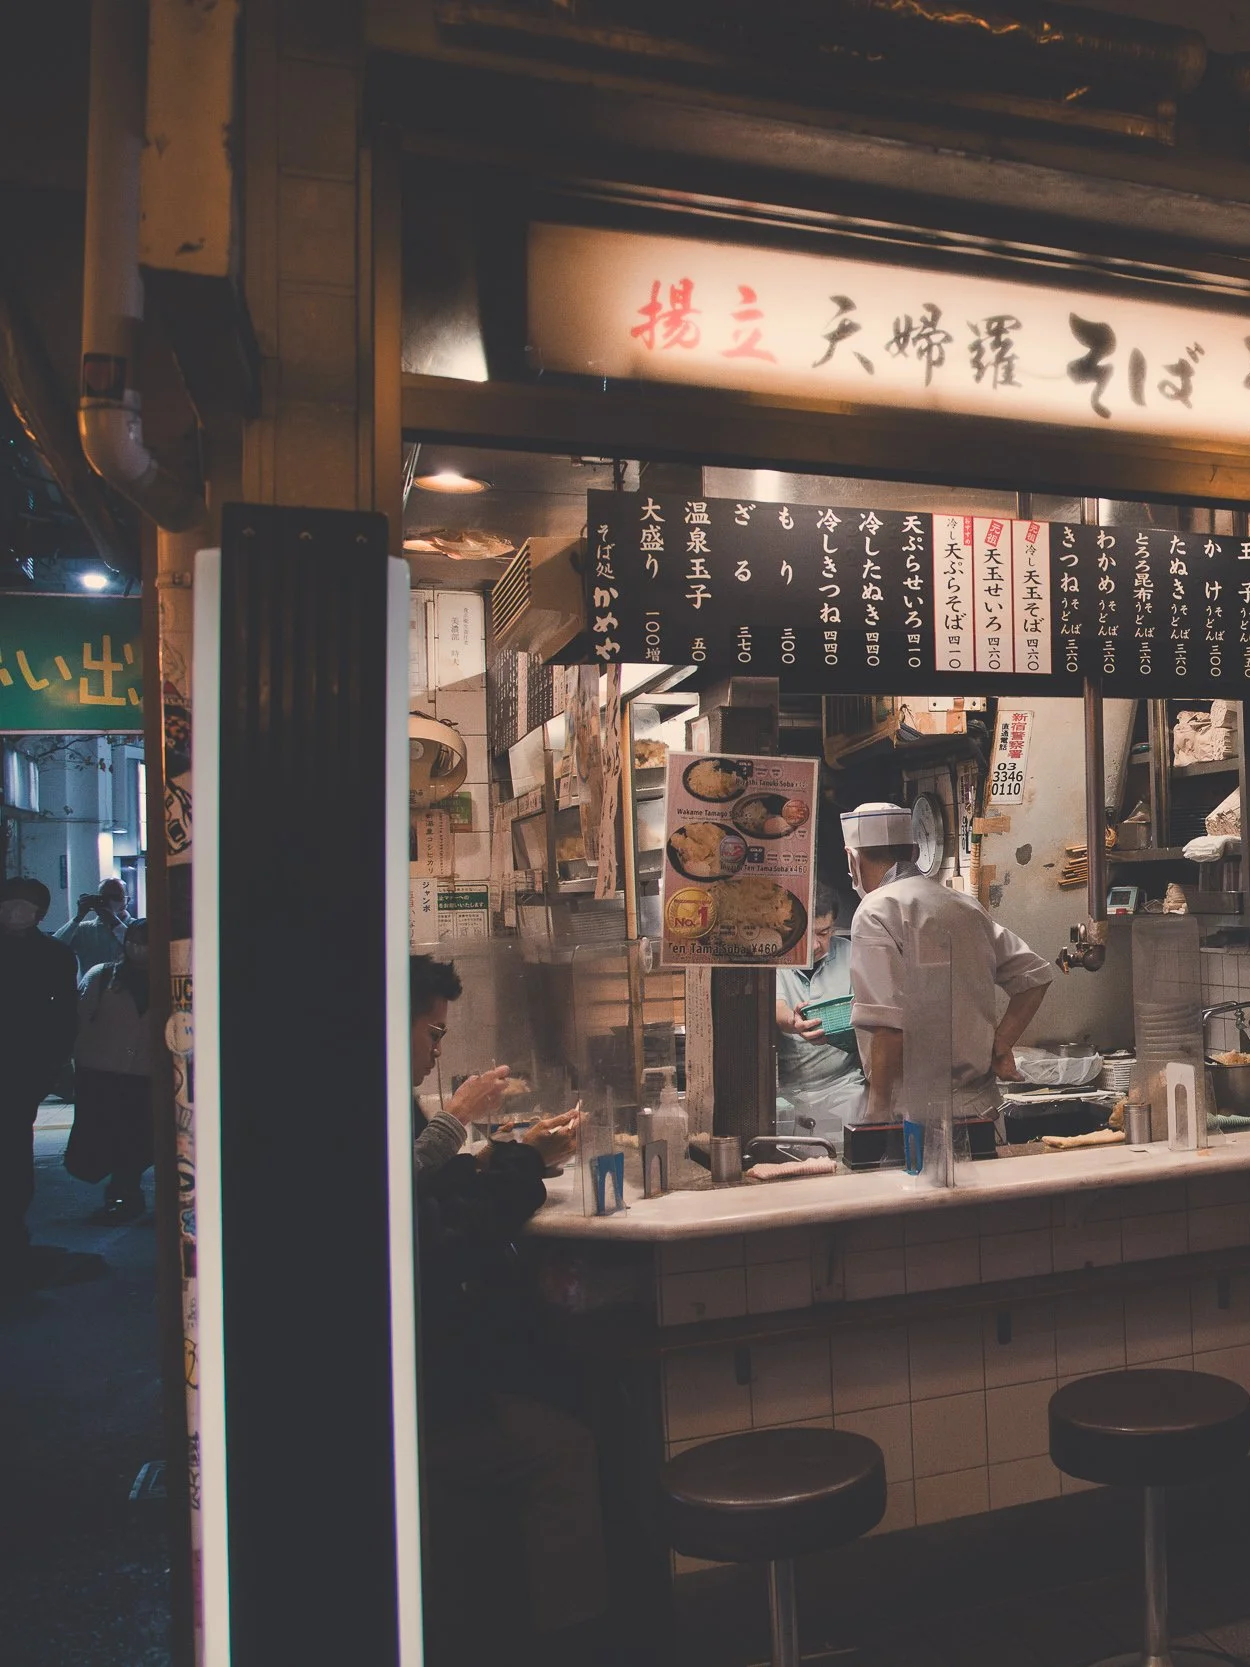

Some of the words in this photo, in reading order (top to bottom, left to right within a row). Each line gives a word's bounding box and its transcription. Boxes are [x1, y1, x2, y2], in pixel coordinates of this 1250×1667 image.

[631, 278, 777, 363] 揚立
[812, 295, 1022, 388] 天婦羅
[1067, 312, 1205, 419] そば
[640, 498, 666, 579] 大盛り
[684, 501, 712, 609] 温泉玉子
[734, 503, 757, 582] ざる
[779, 506, 795, 585] もり
[816, 508, 841, 624] 冷しきつね
[858, 512, 884, 626] 冷したぬき
[902, 515, 924, 629] 天ぷらせいろ
[1060, 526, 1080, 594] きつね
[1097, 530, 1116, 594] わかめ
[1134, 533, 1154, 601] とろろ昆布
[1169, 534, 1188, 599] たぬき
[1203, 538, 1223, 601] かけ
[982, 548, 1005, 631] 天玉せいろ
[691, 637, 706, 662] 五〇
[736, 626, 752, 663] 三七〇
[781, 628, 796, 664] 三〇〇
[824, 630, 838, 665] 四四〇
[866, 632, 880, 666] 四四〇
[907, 633, 921, 668] 四一〇
[947, 635, 961, 669] 四一〇
[987, 637, 1001, 670] 四六〇
[1026, 638, 1040, 671] 四六〇
[1066, 639, 1078, 672] 三六〇
[1103, 640, 1115, 674] 三六〇
[1139, 642, 1151, 675] 三六〇
[1175, 643, 1187, 676] 三六〇
[1209, 647, 1221, 677] 三〇〇
[0, 633, 140, 706] い出
[1007, 713, 1028, 758] 新宿警察署
[993, 771, 1023, 782] 3346
[997, 762, 1017, 770] 03
[991, 783, 1021, 795] 0110
[677, 808, 703, 816] Wakame
[690, 943, 719, 954] Tama
[719, 943, 746, 954] Soba
[752, 943, 777, 955] ¥460
